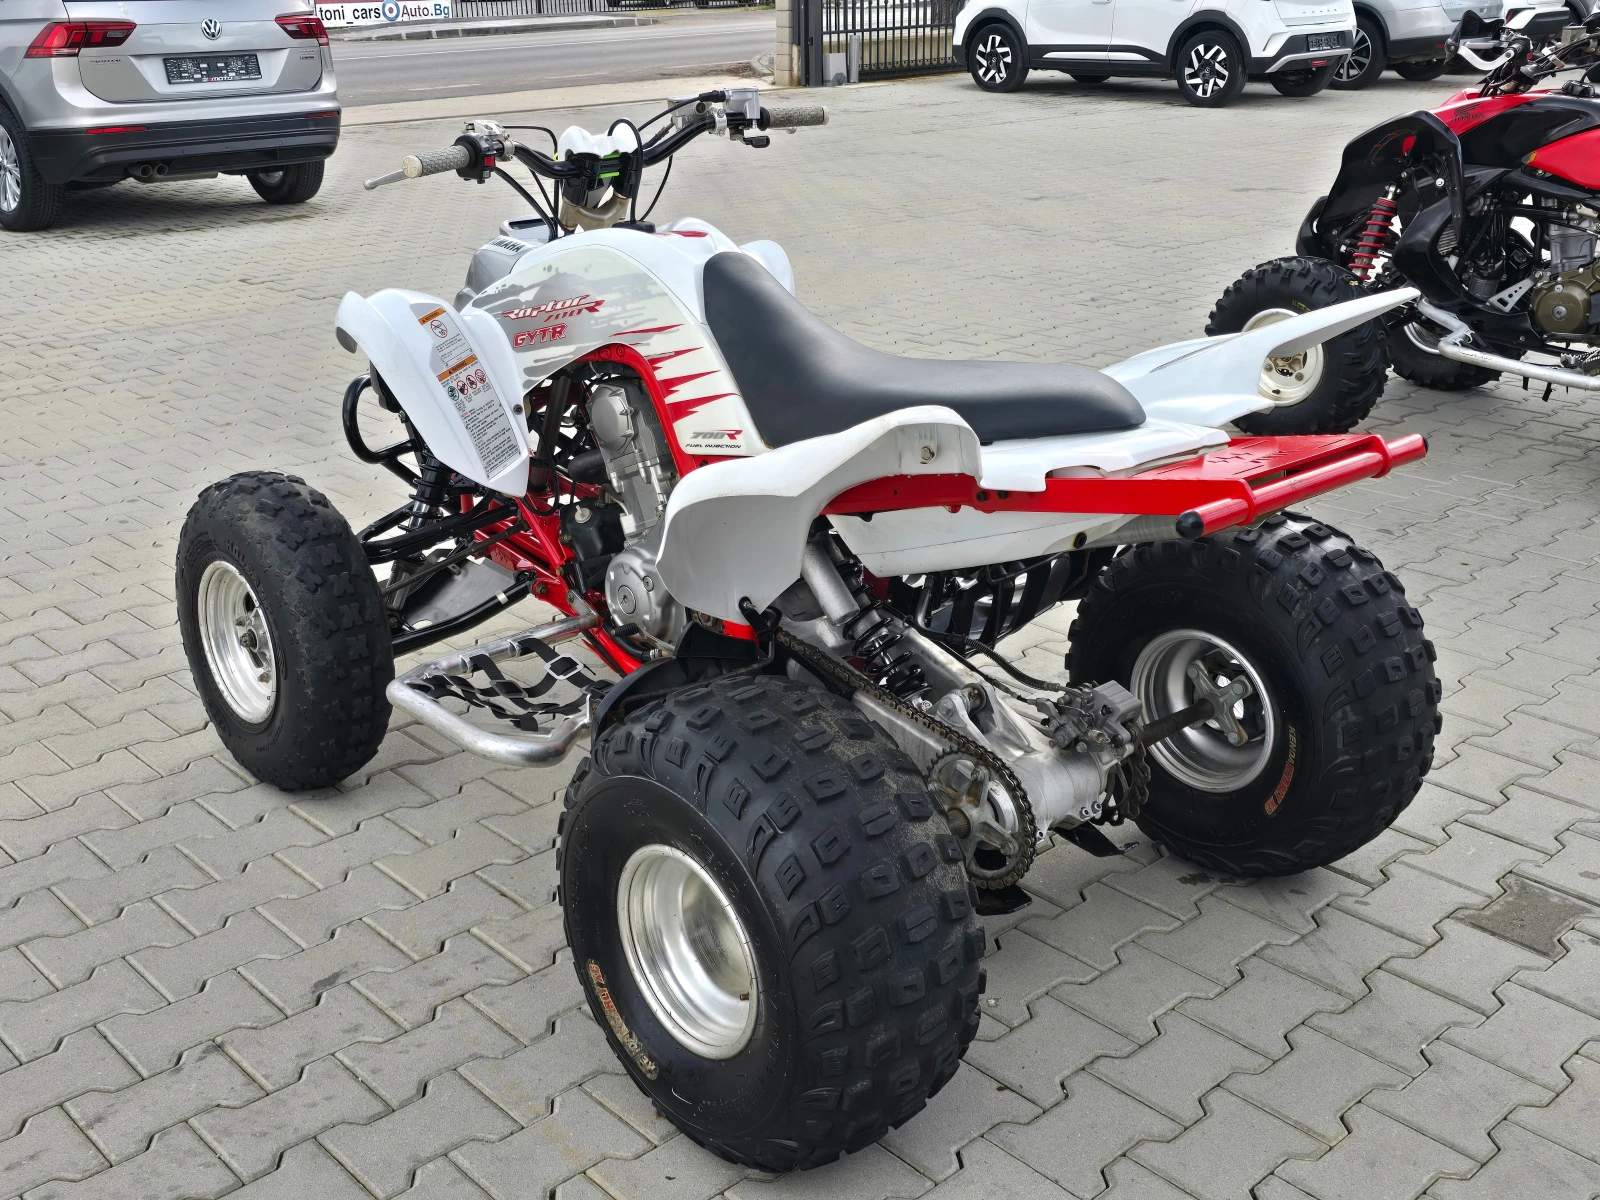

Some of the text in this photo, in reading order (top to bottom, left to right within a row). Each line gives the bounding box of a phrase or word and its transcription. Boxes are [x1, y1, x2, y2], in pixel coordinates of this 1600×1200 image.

[513, 322, 568, 348] GYTR
[690, 430, 742, 440] 700R
[1288, 724, 1297, 765] KENDA
